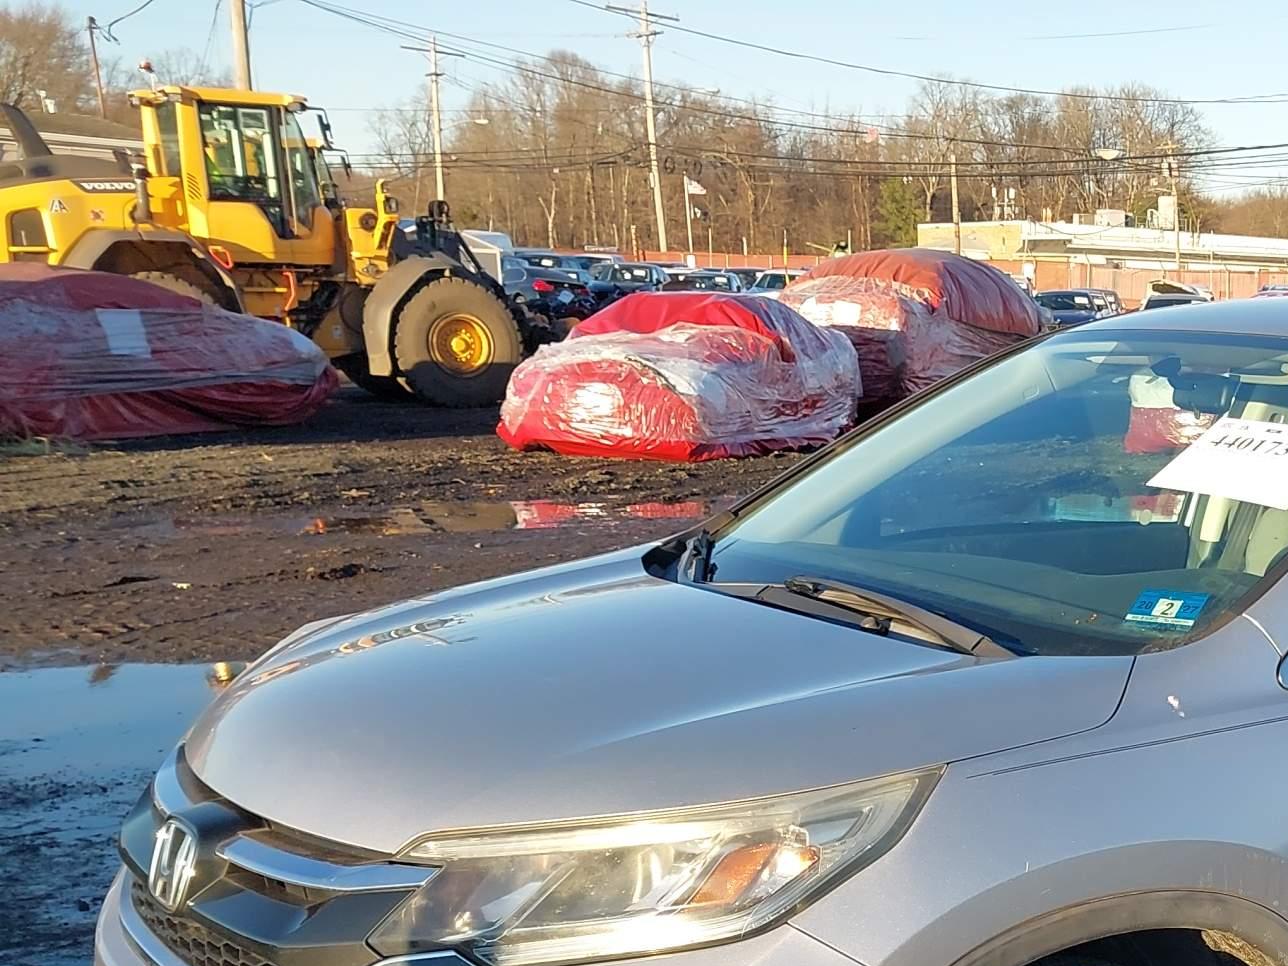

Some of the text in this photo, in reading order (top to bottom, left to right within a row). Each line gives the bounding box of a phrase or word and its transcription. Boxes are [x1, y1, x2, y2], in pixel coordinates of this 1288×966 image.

[80, 182, 136, 190] VOLVO
[1138, 600, 1198, 616] 20 2 27
